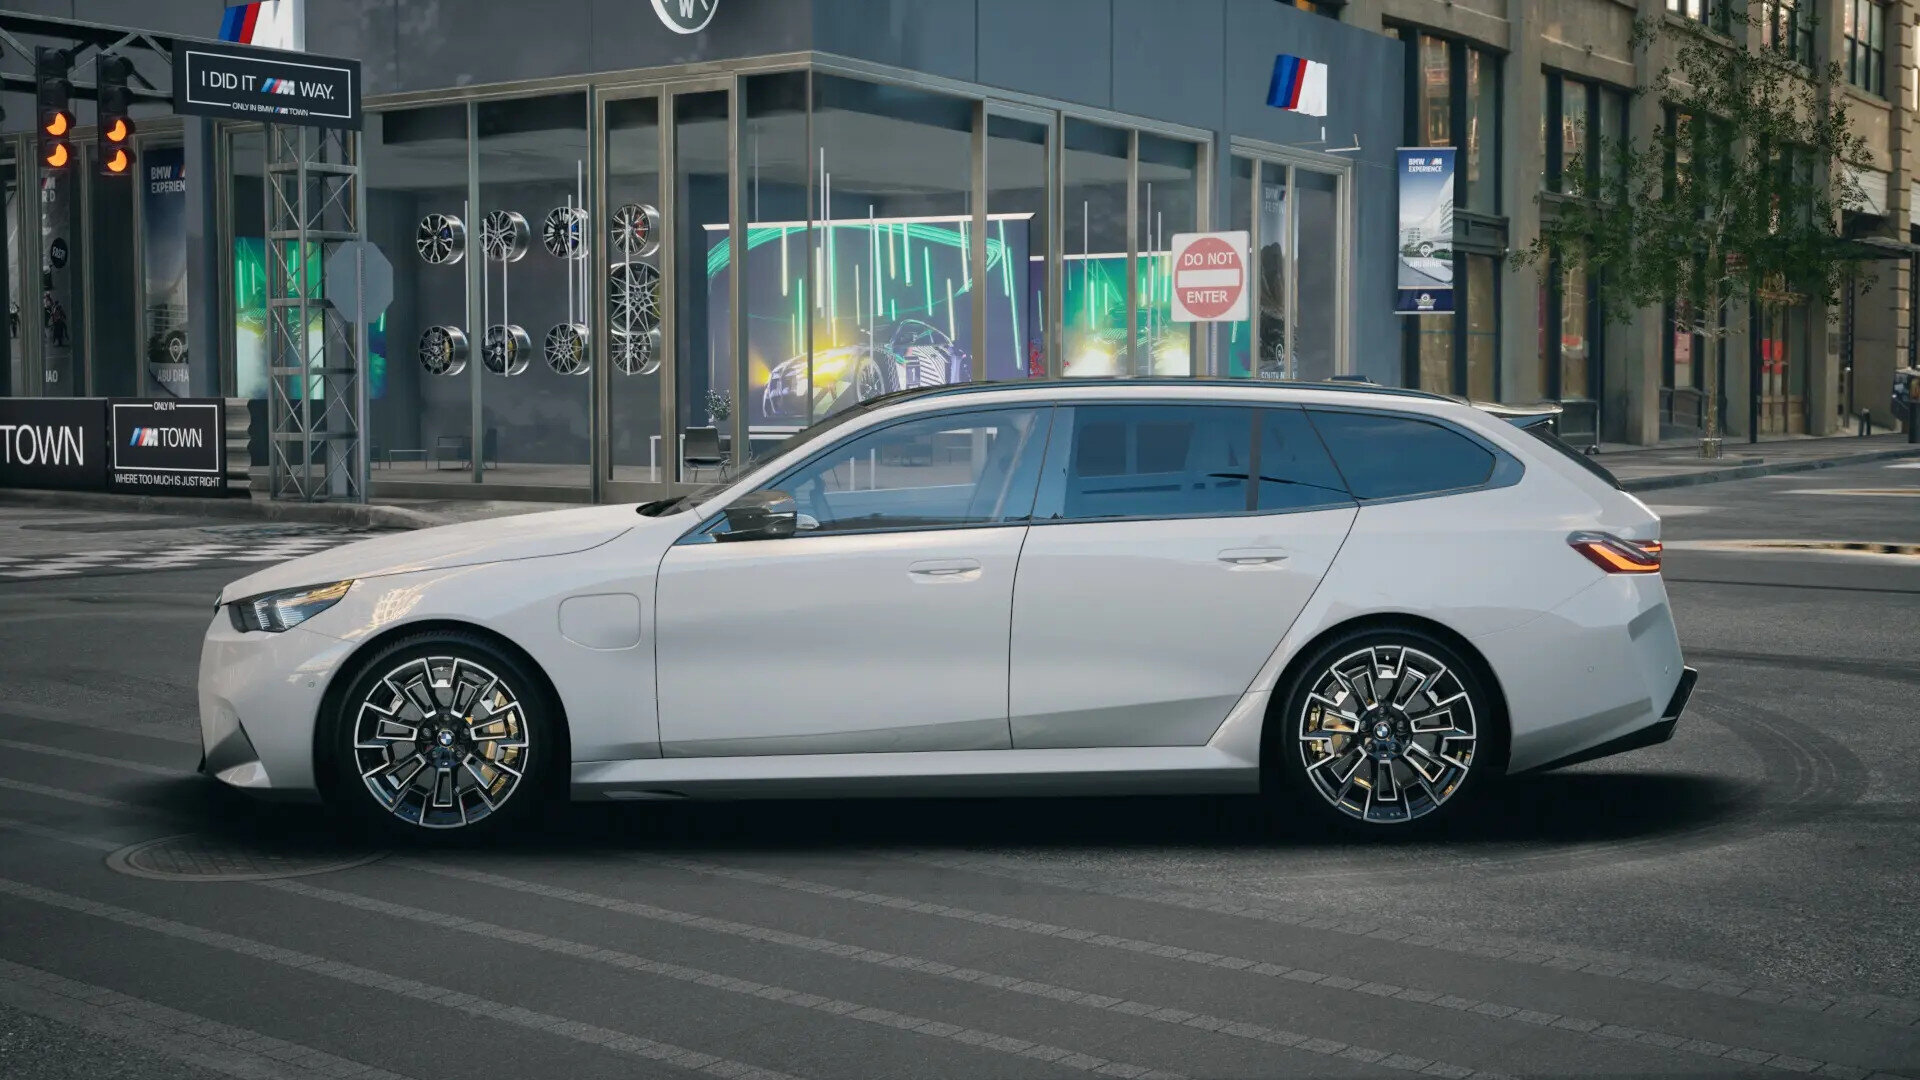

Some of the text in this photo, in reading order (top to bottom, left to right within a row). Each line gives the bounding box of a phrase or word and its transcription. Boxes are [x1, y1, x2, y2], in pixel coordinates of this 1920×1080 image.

[202, 70, 206, 87] I
[210, 71, 238, 90] DID
[242, 75, 257, 92] IT
[299, 81, 335, 100] WAY.
[232, 102, 250, 111] ONLY
[250, 103, 257, 112] IN
[257, 104, 274, 114] BMW
[289, 107, 309, 117] TOWN
[1408, 158, 1425, 166] BMW
[1408, 165, 1443, 173] EXPERIENCE
[151, 165, 172, 180] BMW
[1184, 251, 1235, 266] DO NOT
[1187, 290, 1228, 304] ENTER
[157, 368, 172, 383] ABU
[153, 401, 175, 411] ONLY IN
[0, 424, 84, 466] TOWN
[160, 427, 202, 448] TOWN
[115, 473, 221, 488] WHERE TOO MUCH IS JUST RIGHT
